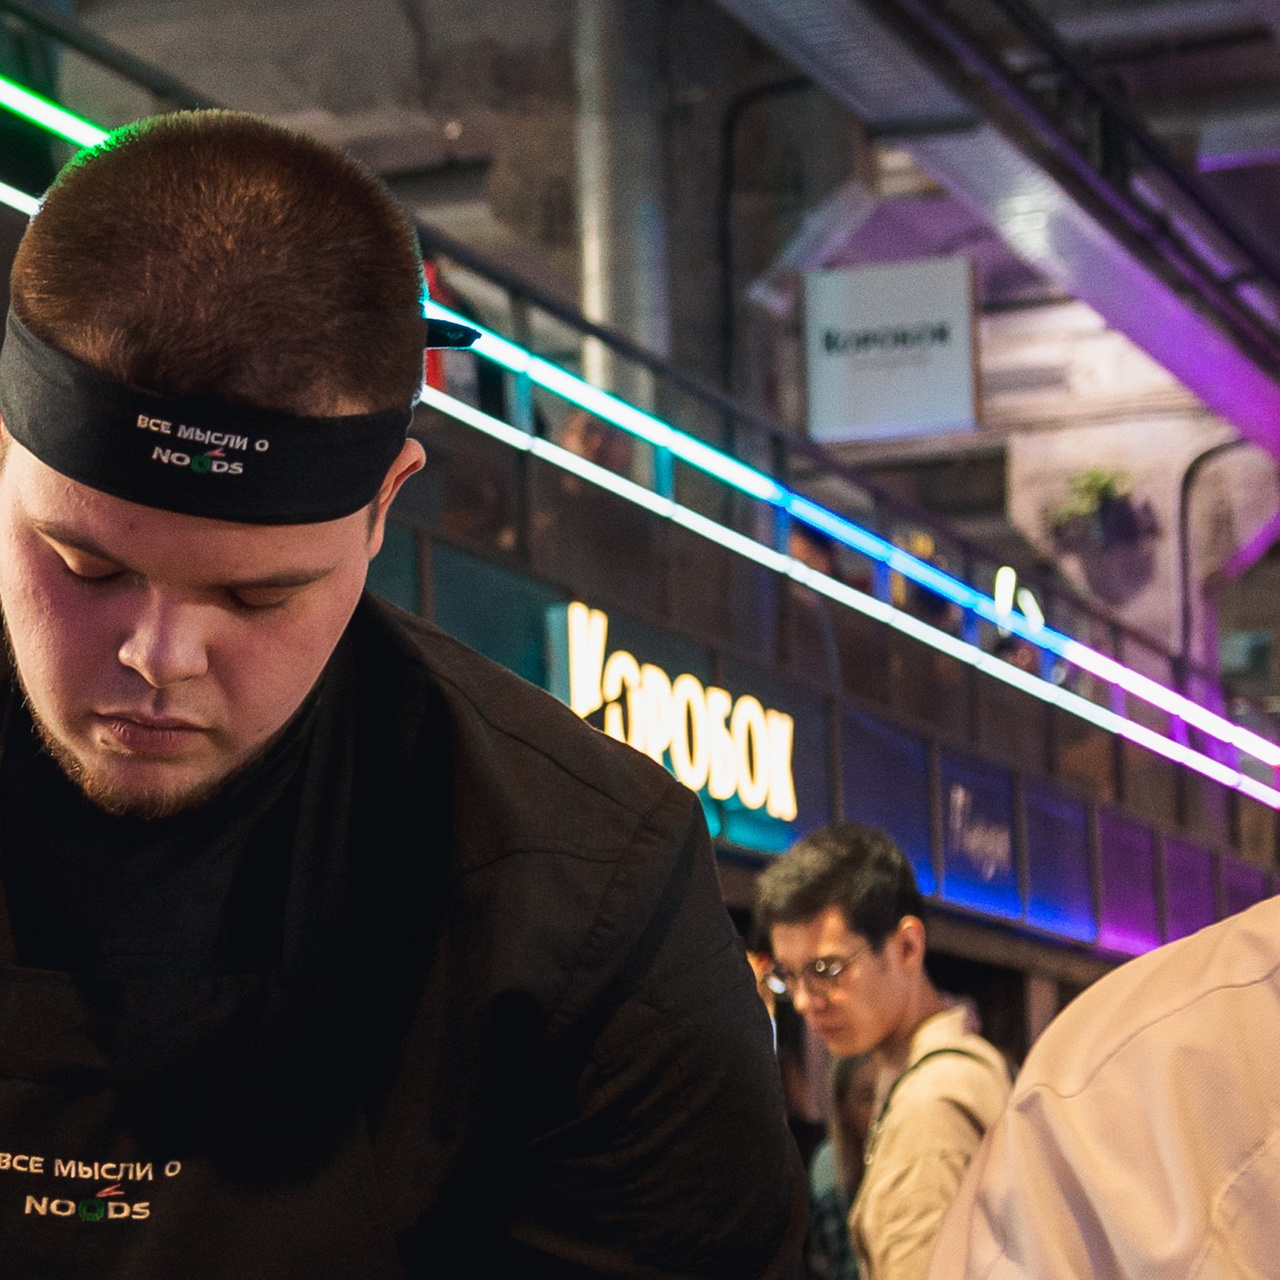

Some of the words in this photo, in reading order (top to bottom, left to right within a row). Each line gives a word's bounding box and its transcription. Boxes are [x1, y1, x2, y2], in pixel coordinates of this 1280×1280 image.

[136, 414, 172, 435] ВСЕ
[176, 424, 248, 451] МЫСЛИ
[254, 438, 270, 453] О
[152, 446, 243, 475] NOODS
[54, 1159, 153, 1181] МЫСЛИ
[164, 1160, 182, 1177] О
[24, 1195, 151, 1221] NOODS
